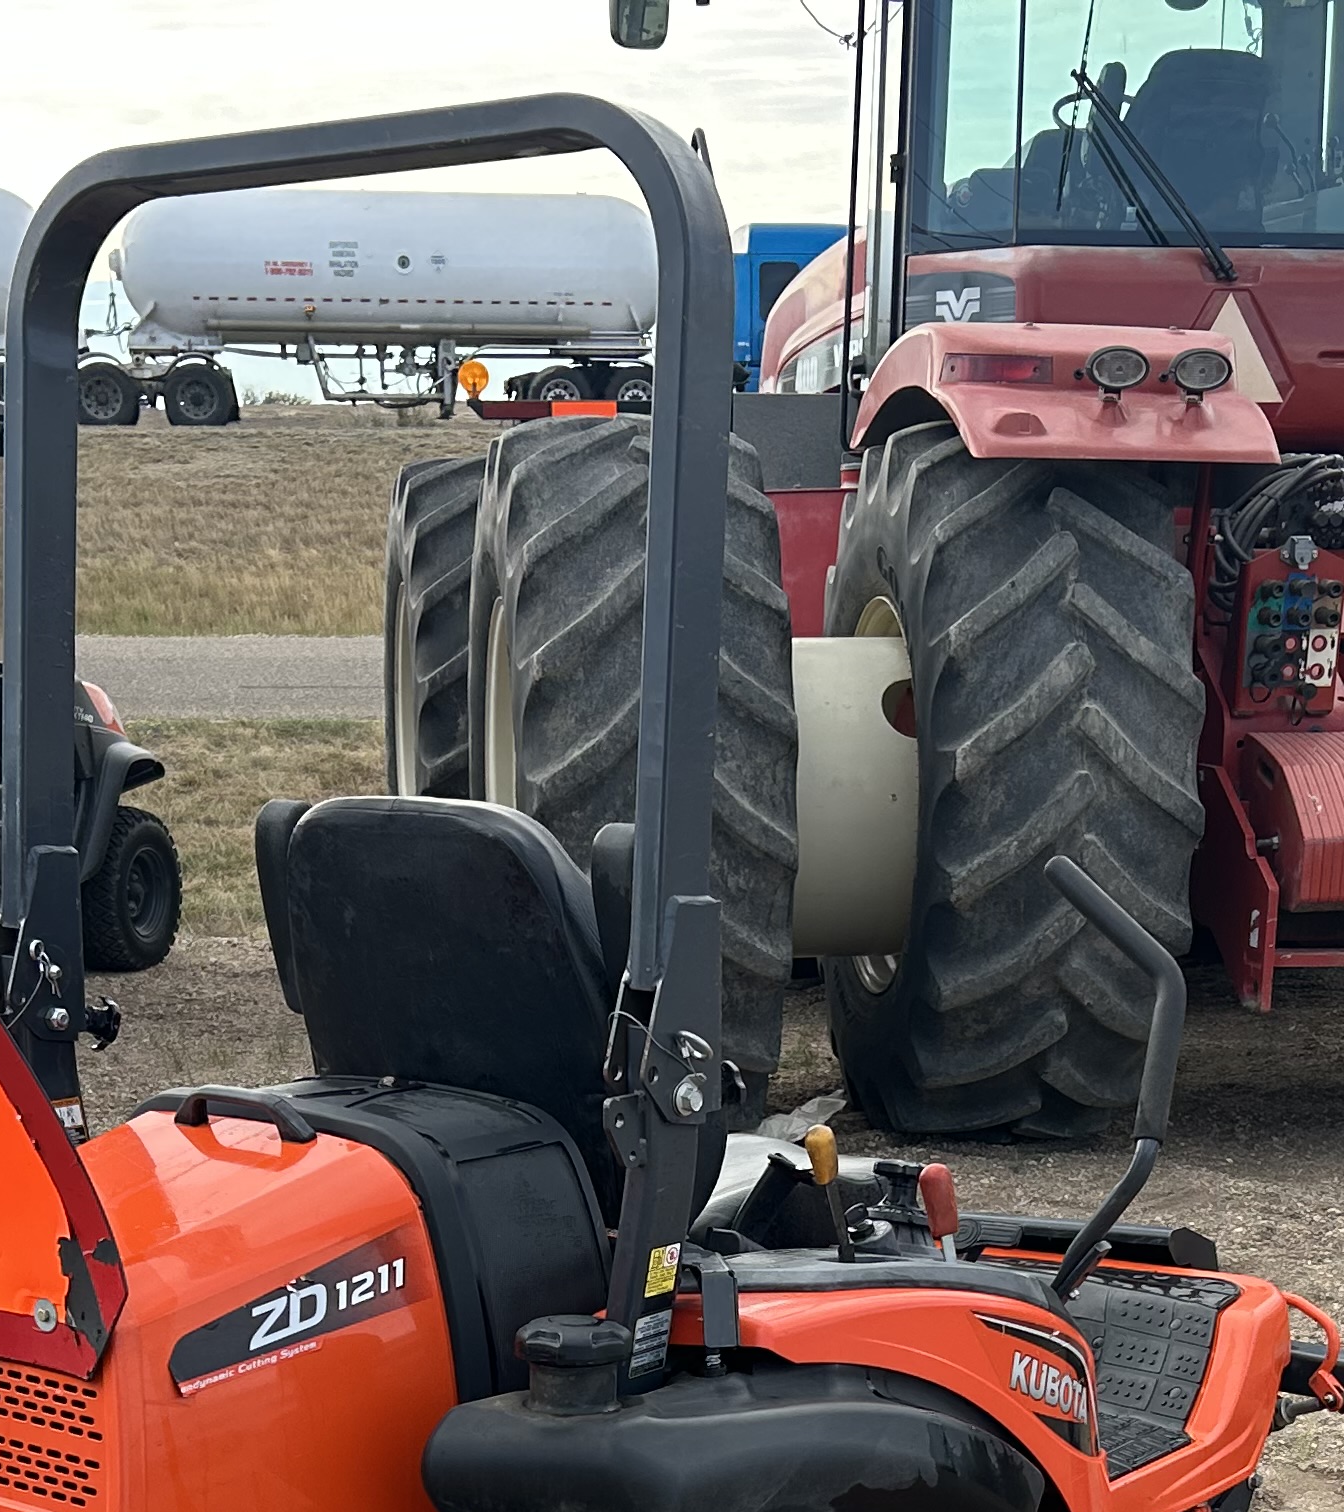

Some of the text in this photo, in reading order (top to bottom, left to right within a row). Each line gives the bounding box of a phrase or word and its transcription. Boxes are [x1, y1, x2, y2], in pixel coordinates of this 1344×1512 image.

[249, 1257, 405, 1351] ZD 1211
[238, 1354, 278, 1374] Cutting
[280, 1341, 317, 1360] System
[1009, 1351, 1088, 1425] KUBOTA
